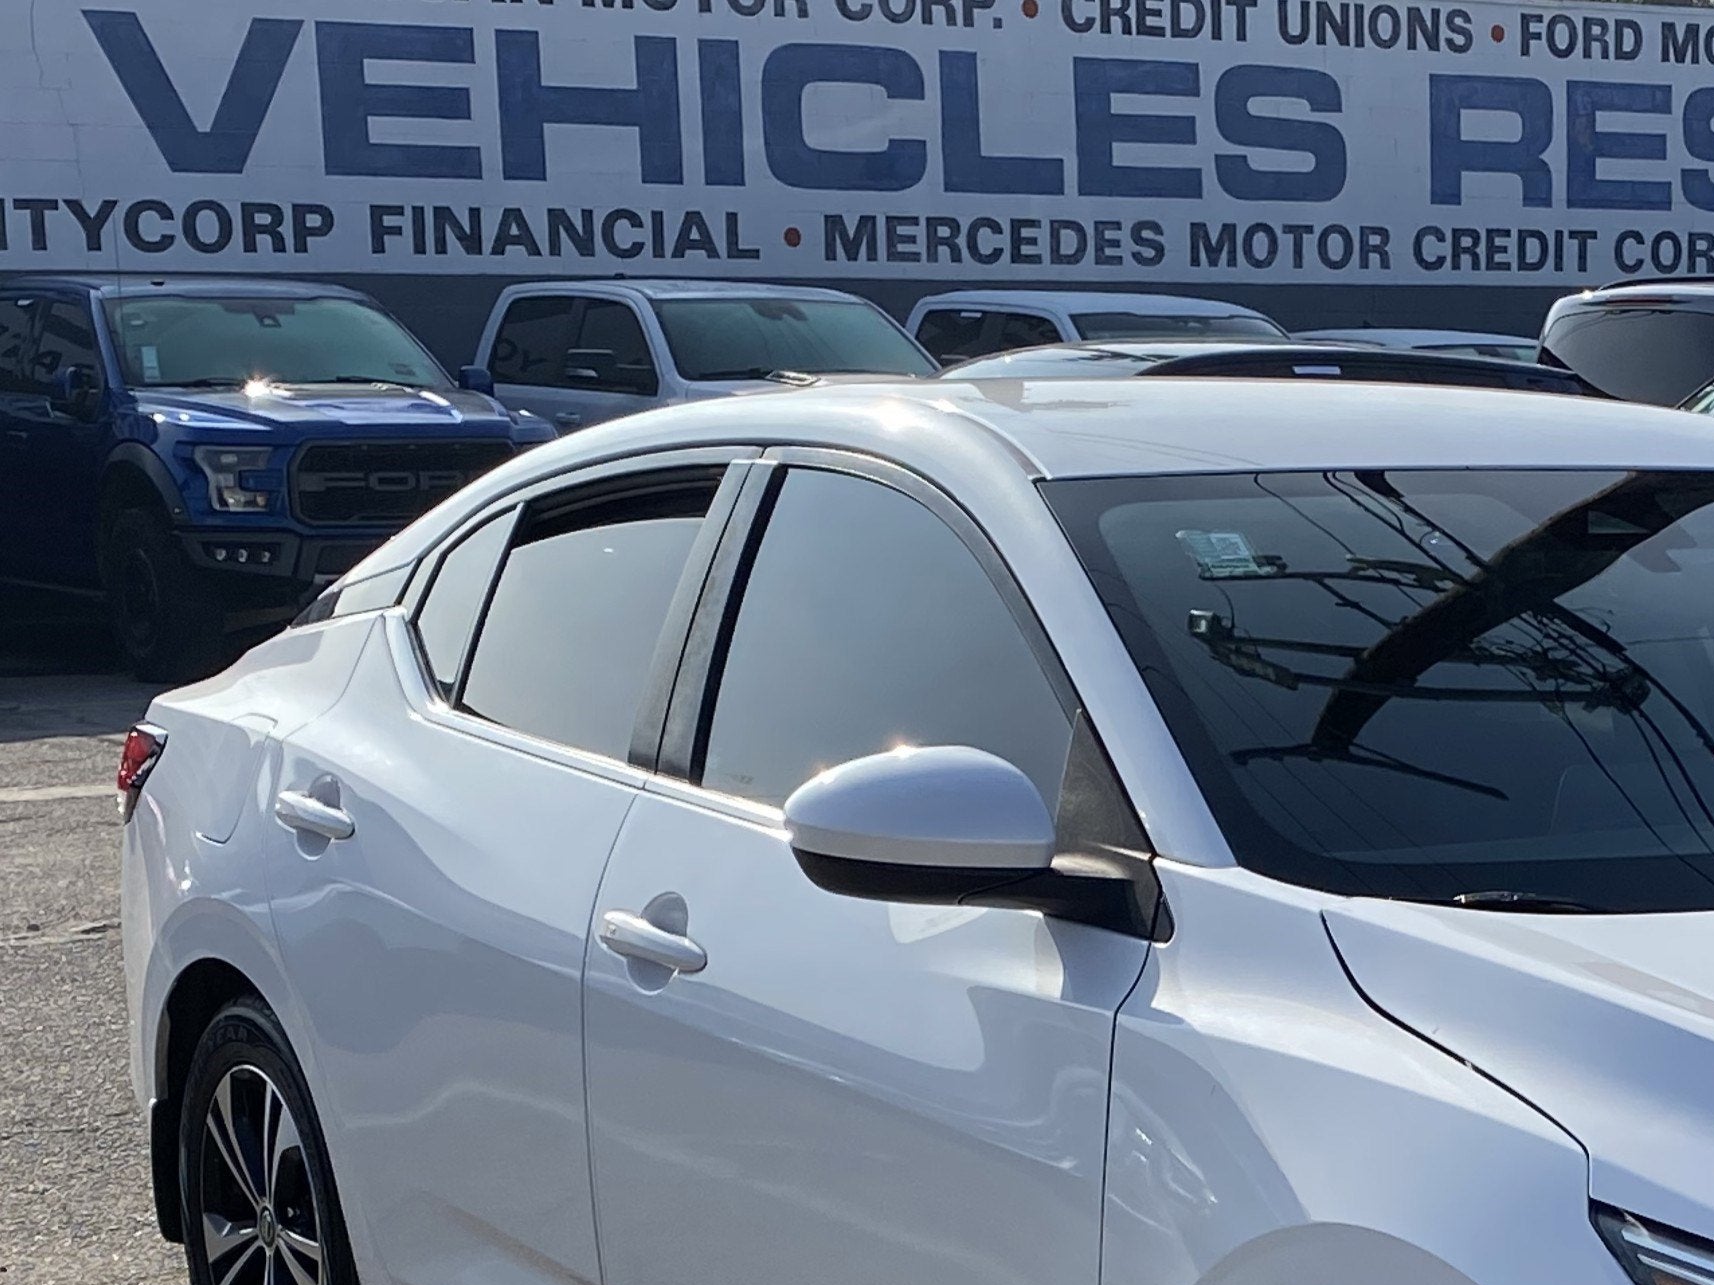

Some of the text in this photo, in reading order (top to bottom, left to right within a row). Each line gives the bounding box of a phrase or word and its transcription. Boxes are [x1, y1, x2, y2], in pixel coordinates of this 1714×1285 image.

[1060, 0, 1258, 42] CREDIT
[1278, 0, 1474, 54] UNIONS
[1519, 13, 1644, 63] FORD
[80, 8, 1348, 203] VEHICLES
[369, 203, 762, 262] FINANCIAL
[823, 213, 1166, 268] MERCEDES
[1189, 221, 1393, 272] MOTOR
[1412, 226, 1598, 274] CREDIT
[299, 470, 466, 492] FOR
